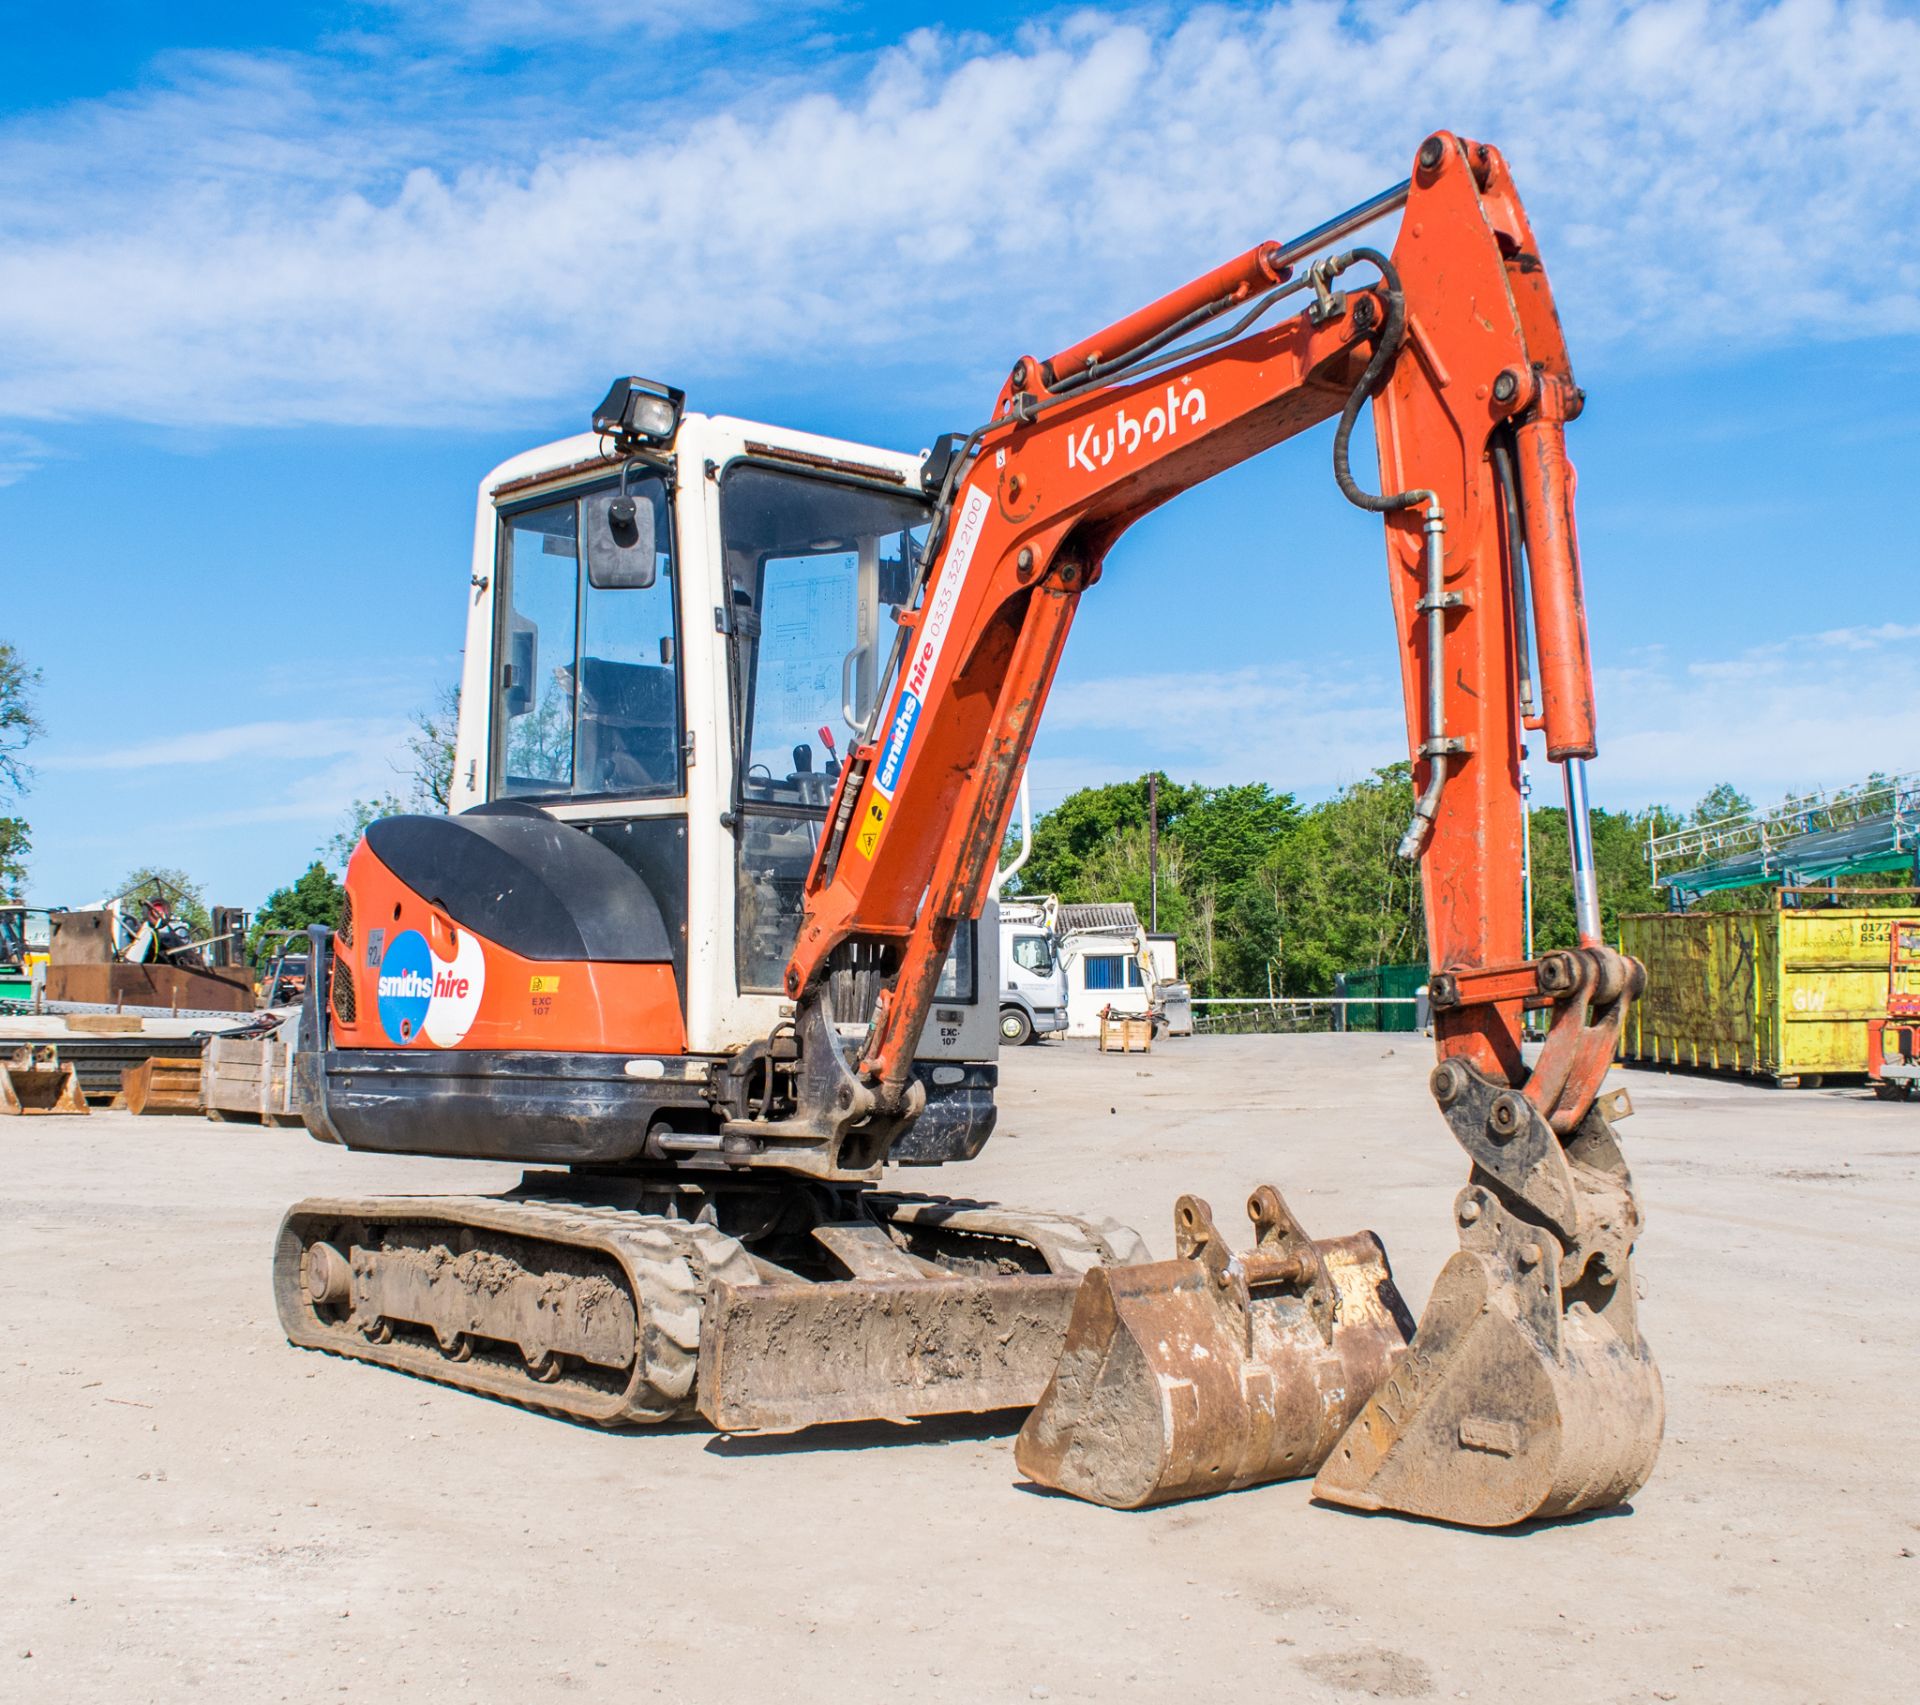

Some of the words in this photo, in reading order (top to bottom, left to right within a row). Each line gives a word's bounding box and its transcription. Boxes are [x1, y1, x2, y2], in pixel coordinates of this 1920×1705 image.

[1068, 385, 1206, 472] Kubota
[881, 695, 917, 787] smiths
[909, 642, 934, 696] hire
[930, 588, 952, 637] 0333
[947, 548, 965, 585] 323
[960, 497, 982, 545] 2100
[378, 968, 432, 998] smiths
[434, 969, 469, 998] hire
[532, 997, 552, 1006] EXC
[533, 1007, 550, 1015] 107
[942, 1037, 956, 1046] 107
